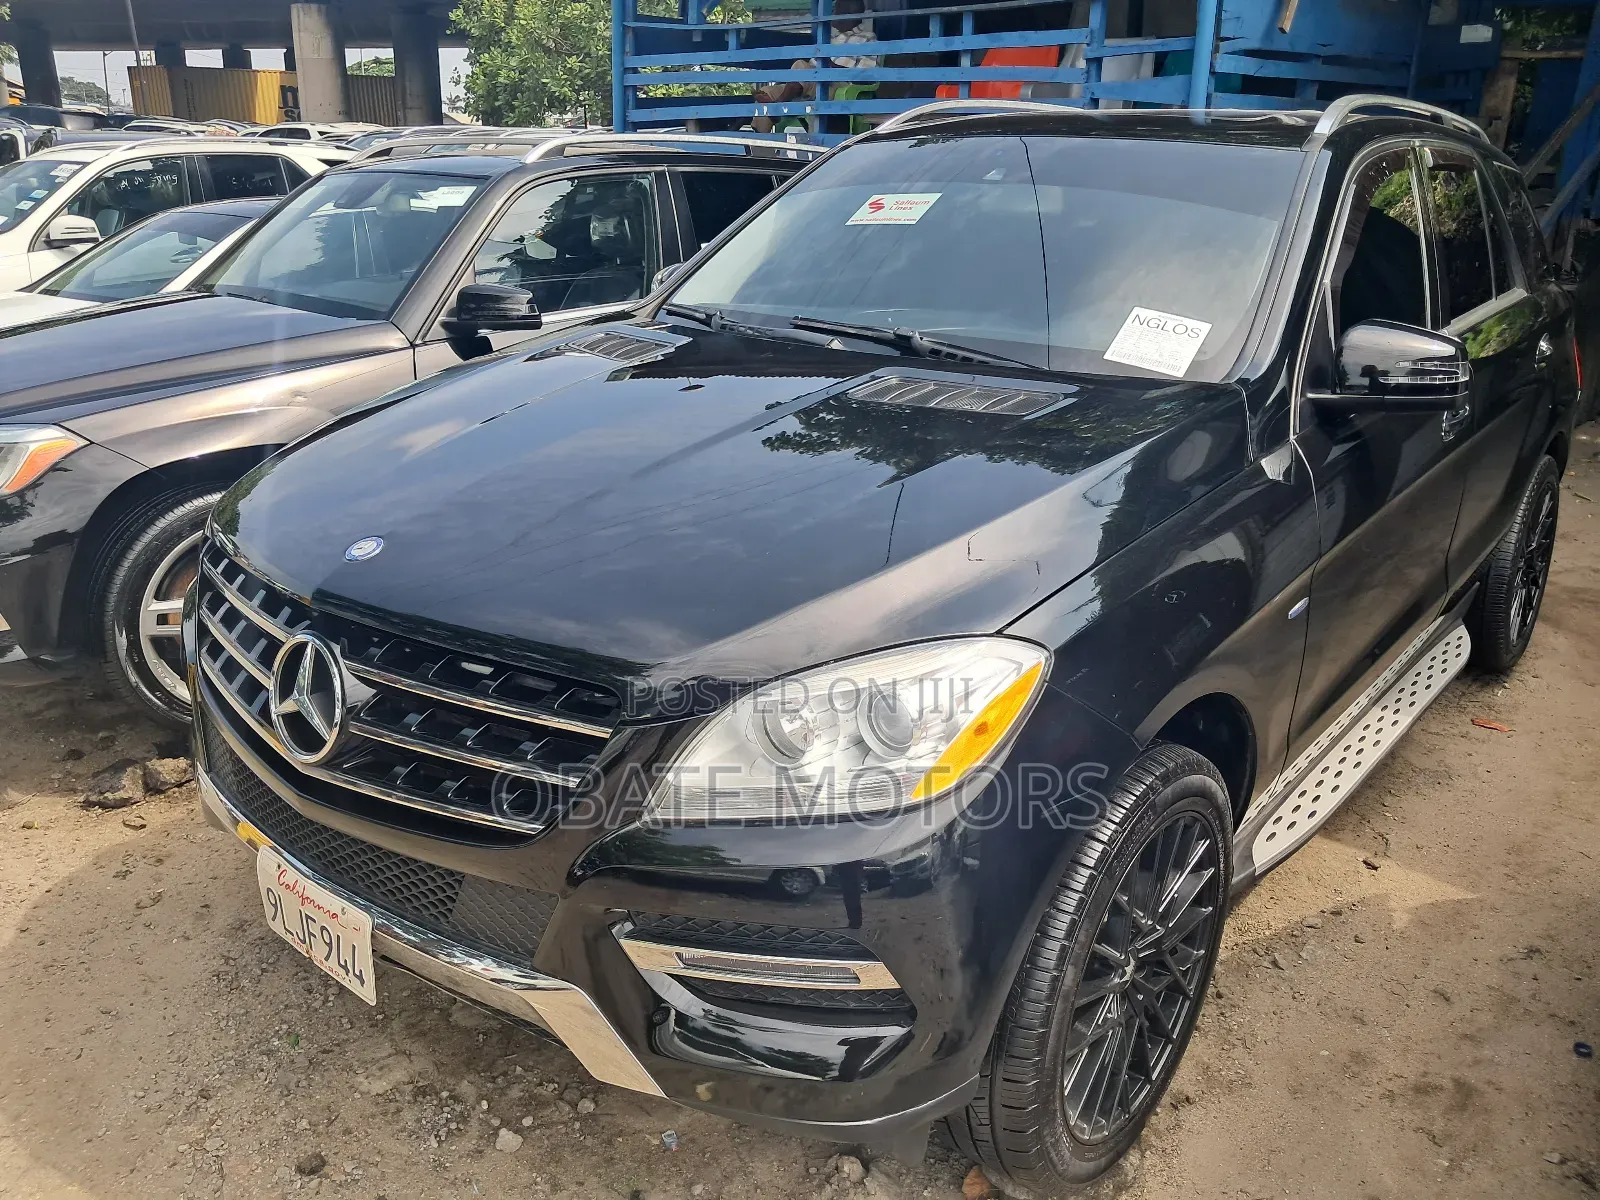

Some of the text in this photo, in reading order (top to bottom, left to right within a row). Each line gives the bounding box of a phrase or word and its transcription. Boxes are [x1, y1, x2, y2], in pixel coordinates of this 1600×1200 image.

[1131, 313, 1202, 339] NGLOS
[277, 869, 348, 929] California
[266, 887, 366, 988] 9LJF944
